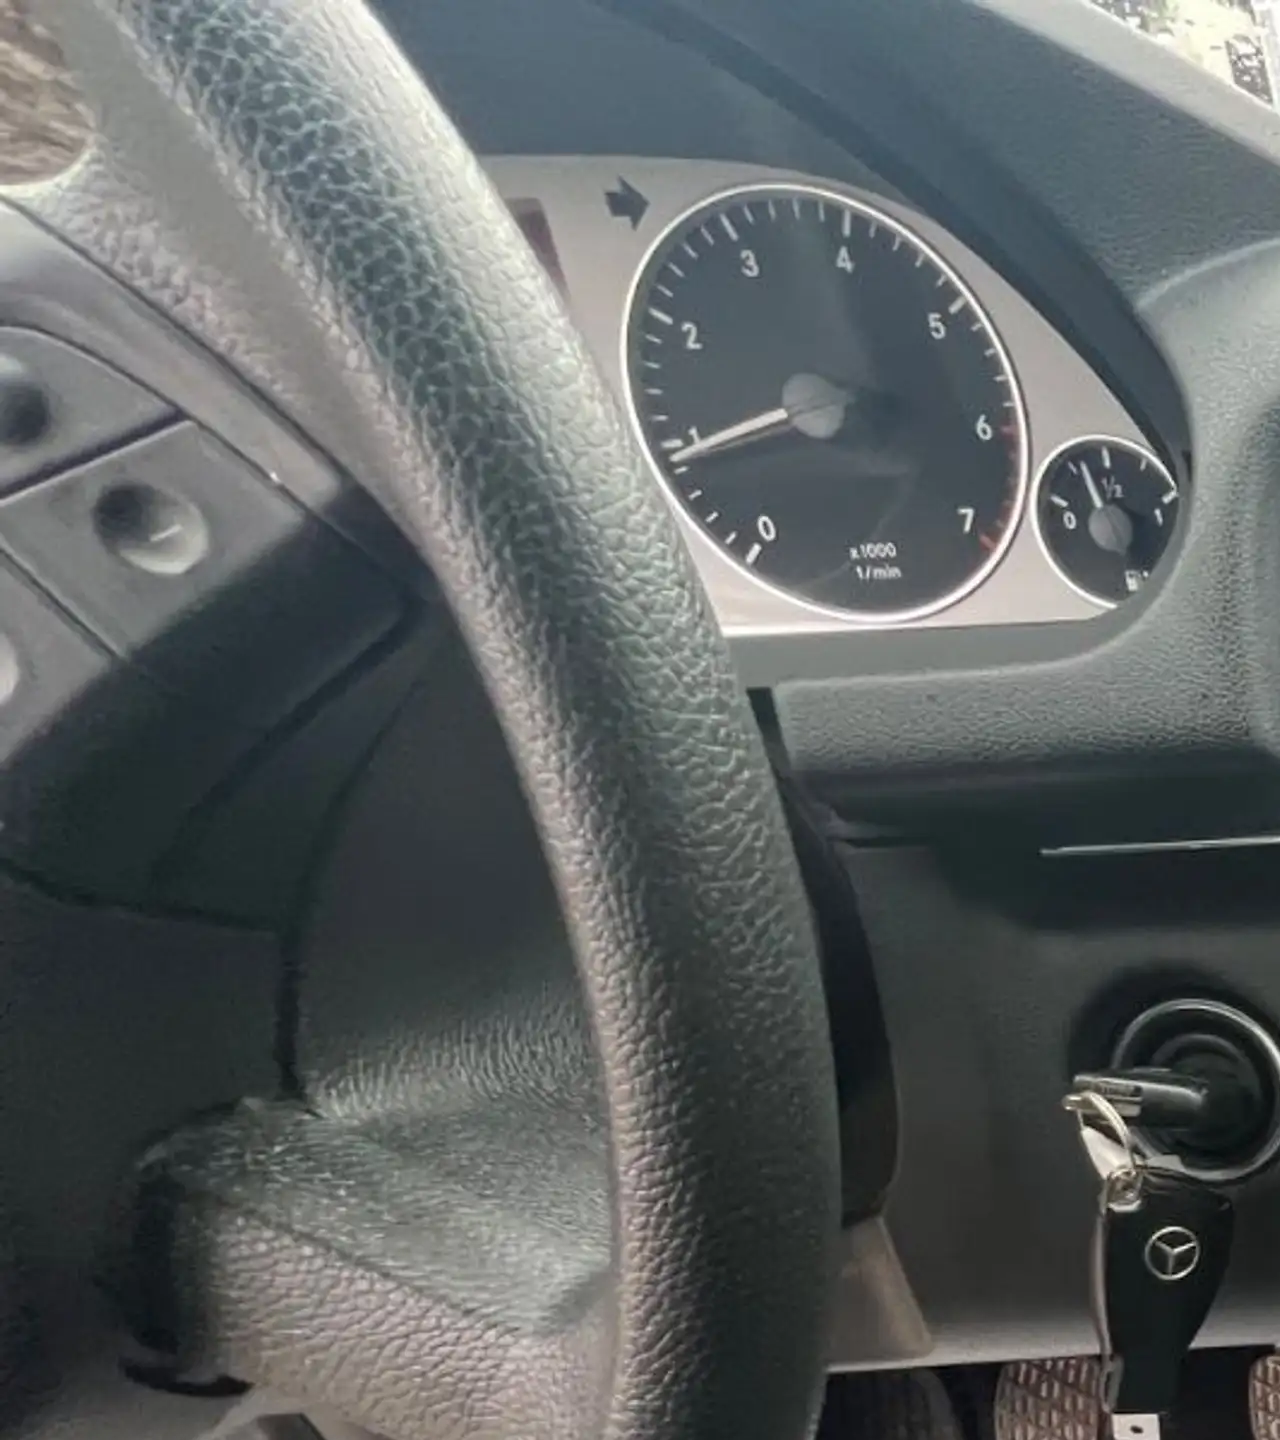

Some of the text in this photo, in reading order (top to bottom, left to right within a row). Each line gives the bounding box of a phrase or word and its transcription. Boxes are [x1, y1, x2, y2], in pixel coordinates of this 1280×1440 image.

[740, 249, 760, 278] 3
[836, 246, 855, 273] 4
[681, 322, 703, 350] 2
[927, 312, 946, 340] 5
[976, 414, 993, 441] 6
[757, 515, 776, 541] 0
[957, 507, 975, 534] 7
[1063, 512, 1077, 530] 0
[1154, 508, 1163, 527] 1
